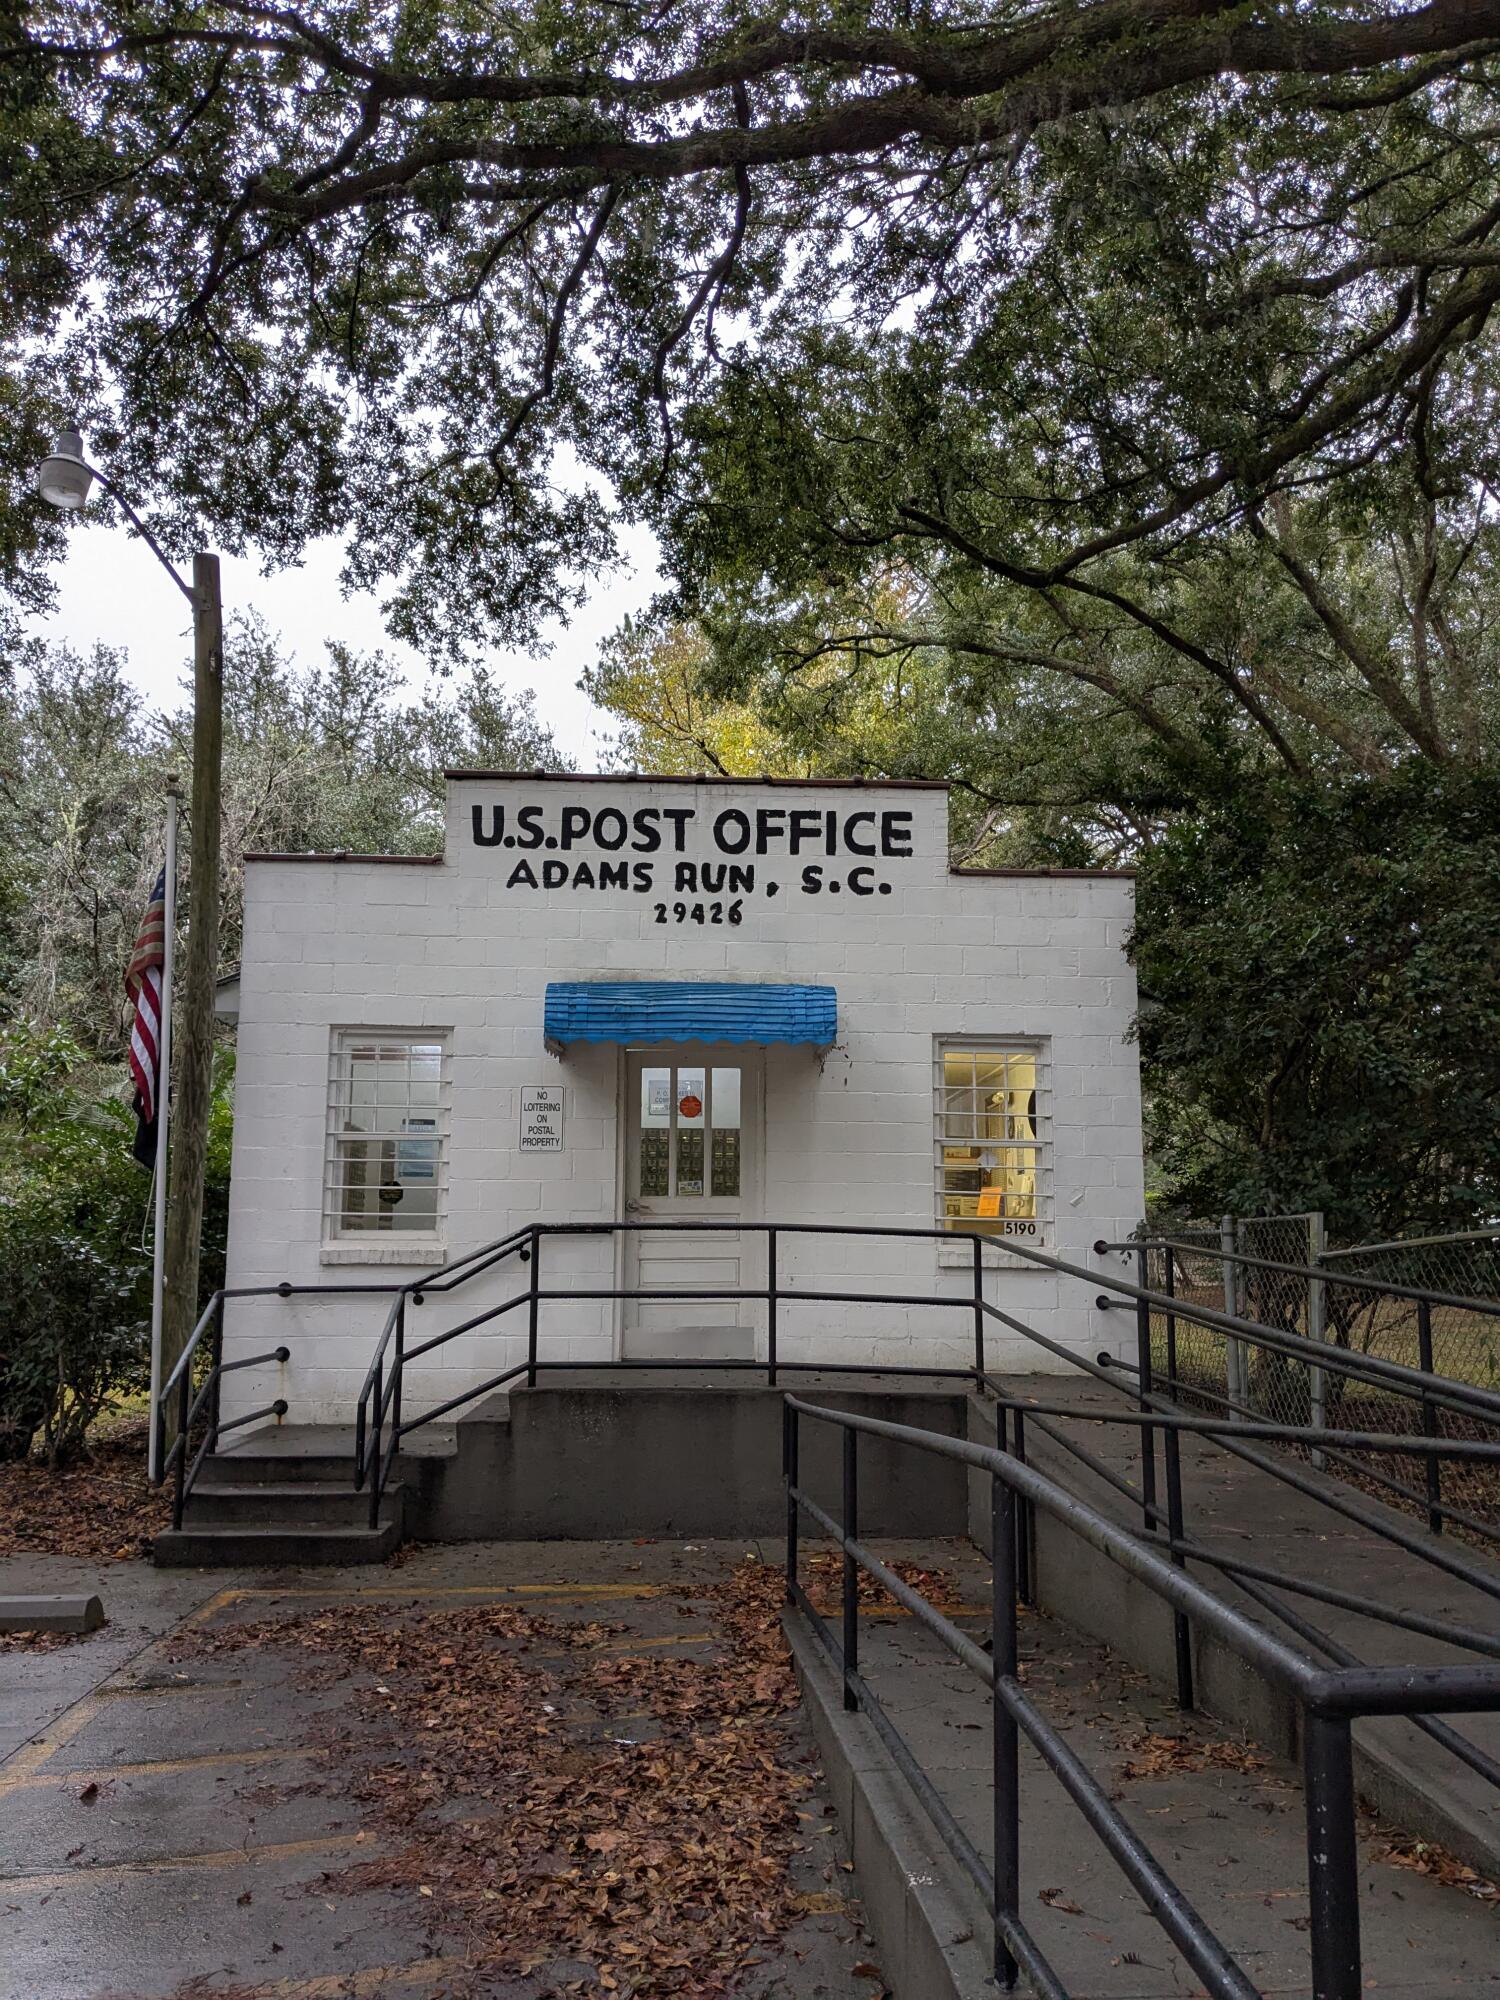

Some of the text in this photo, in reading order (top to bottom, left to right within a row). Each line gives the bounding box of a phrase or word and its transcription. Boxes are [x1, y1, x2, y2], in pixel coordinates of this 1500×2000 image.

[712, 808, 914, 857] OFFICE
[506, 858, 654, 893] ADAMS
[801, 865, 892, 896] S.C.
[653, 898, 744, 926] 29426
[537, 1091, 548, 1100] NO
[523, 1102, 561, 1112] LOITERING
[536, 1114, 548, 1123] ON
[527, 1125, 555, 1135] POSTAL
[522, 1137, 560, 1147] PROPERTY
[1005, 1222, 1036, 1236] 5190
